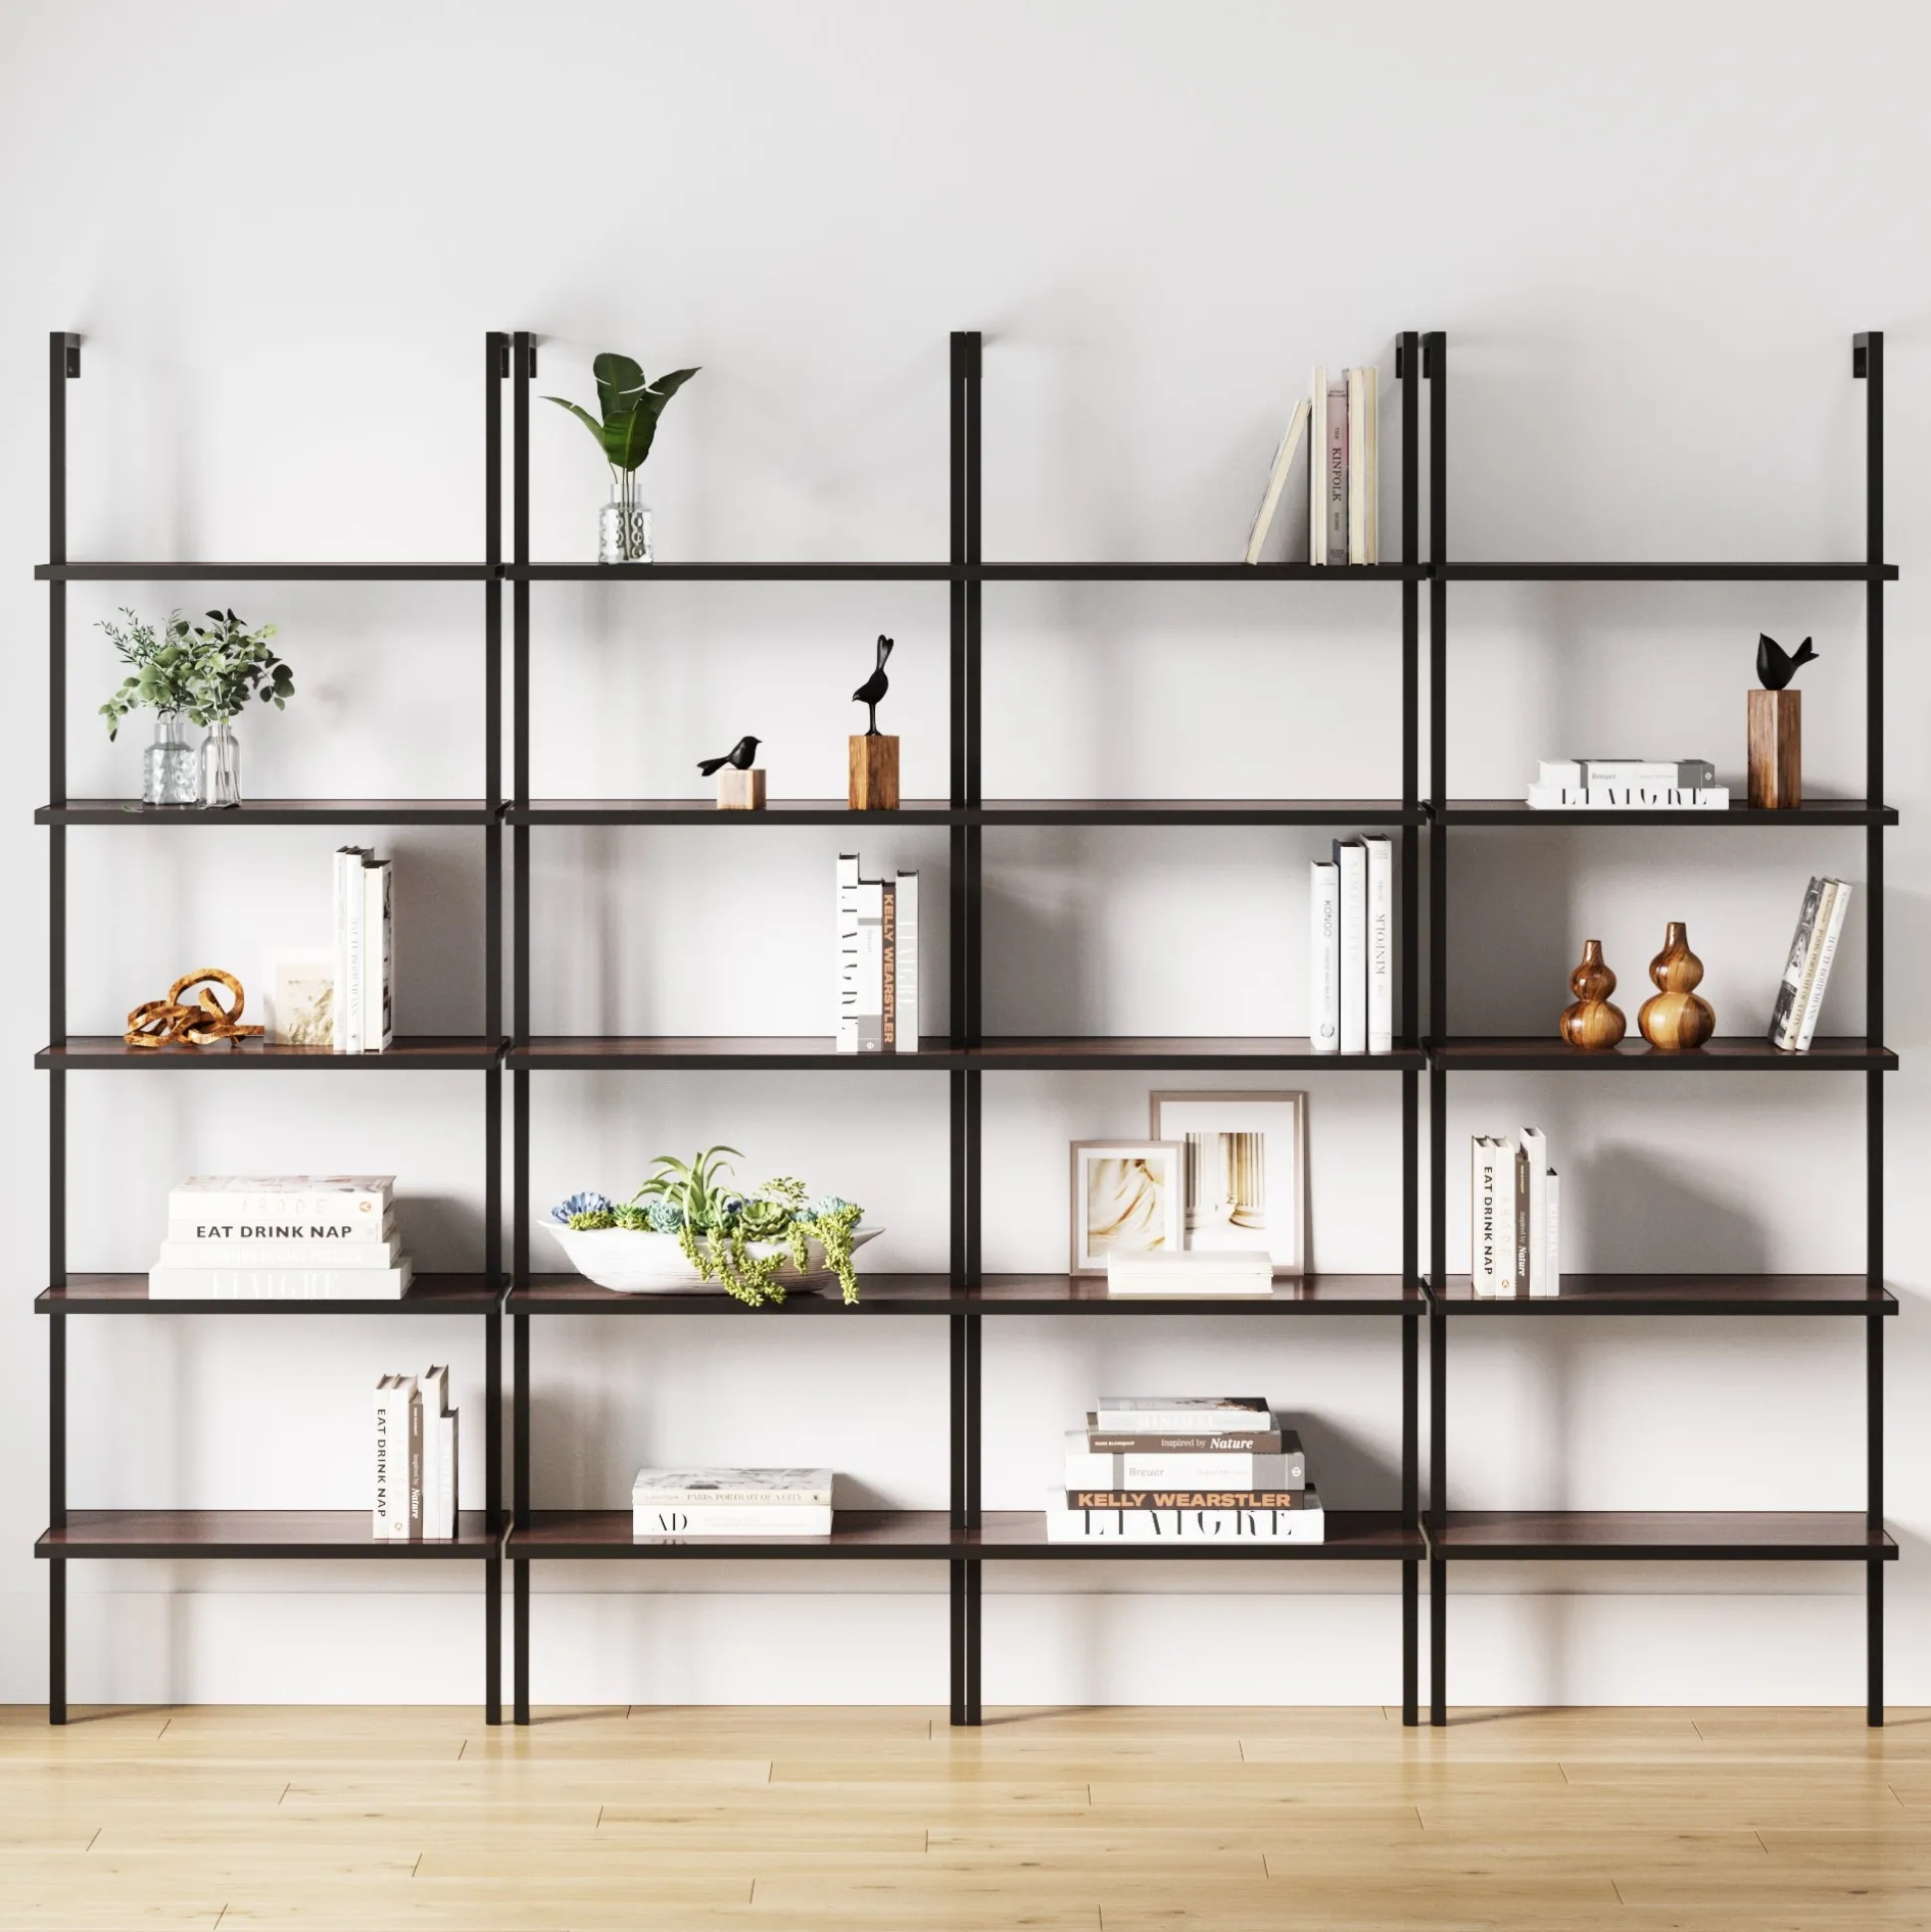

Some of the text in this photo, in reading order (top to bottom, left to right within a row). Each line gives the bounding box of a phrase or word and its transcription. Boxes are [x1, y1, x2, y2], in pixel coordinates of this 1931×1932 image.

[1332, 447, 1342, 502] KINFOLK
[1375, 914, 1386, 974] KINFOLK
[883, 894, 894, 1043] KELLY WEARSTLER
[196, 1225, 352, 1238] EAT DRINK NAP
[1484, 1167, 1493, 1275] EAT DRINK NAP
[1161, 1437, 1254, 1449] Inspired by Nature
[377, 1408, 386, 1517] EAT DRINK NAP
[1129, 1467, 1165, 1477] Breuer
[411, 1487, 420, 1519] Nature
[1078, 1493, 1291, 1507] KELLY WEARSTLER
[651, 1512, 688, 1532] AD
